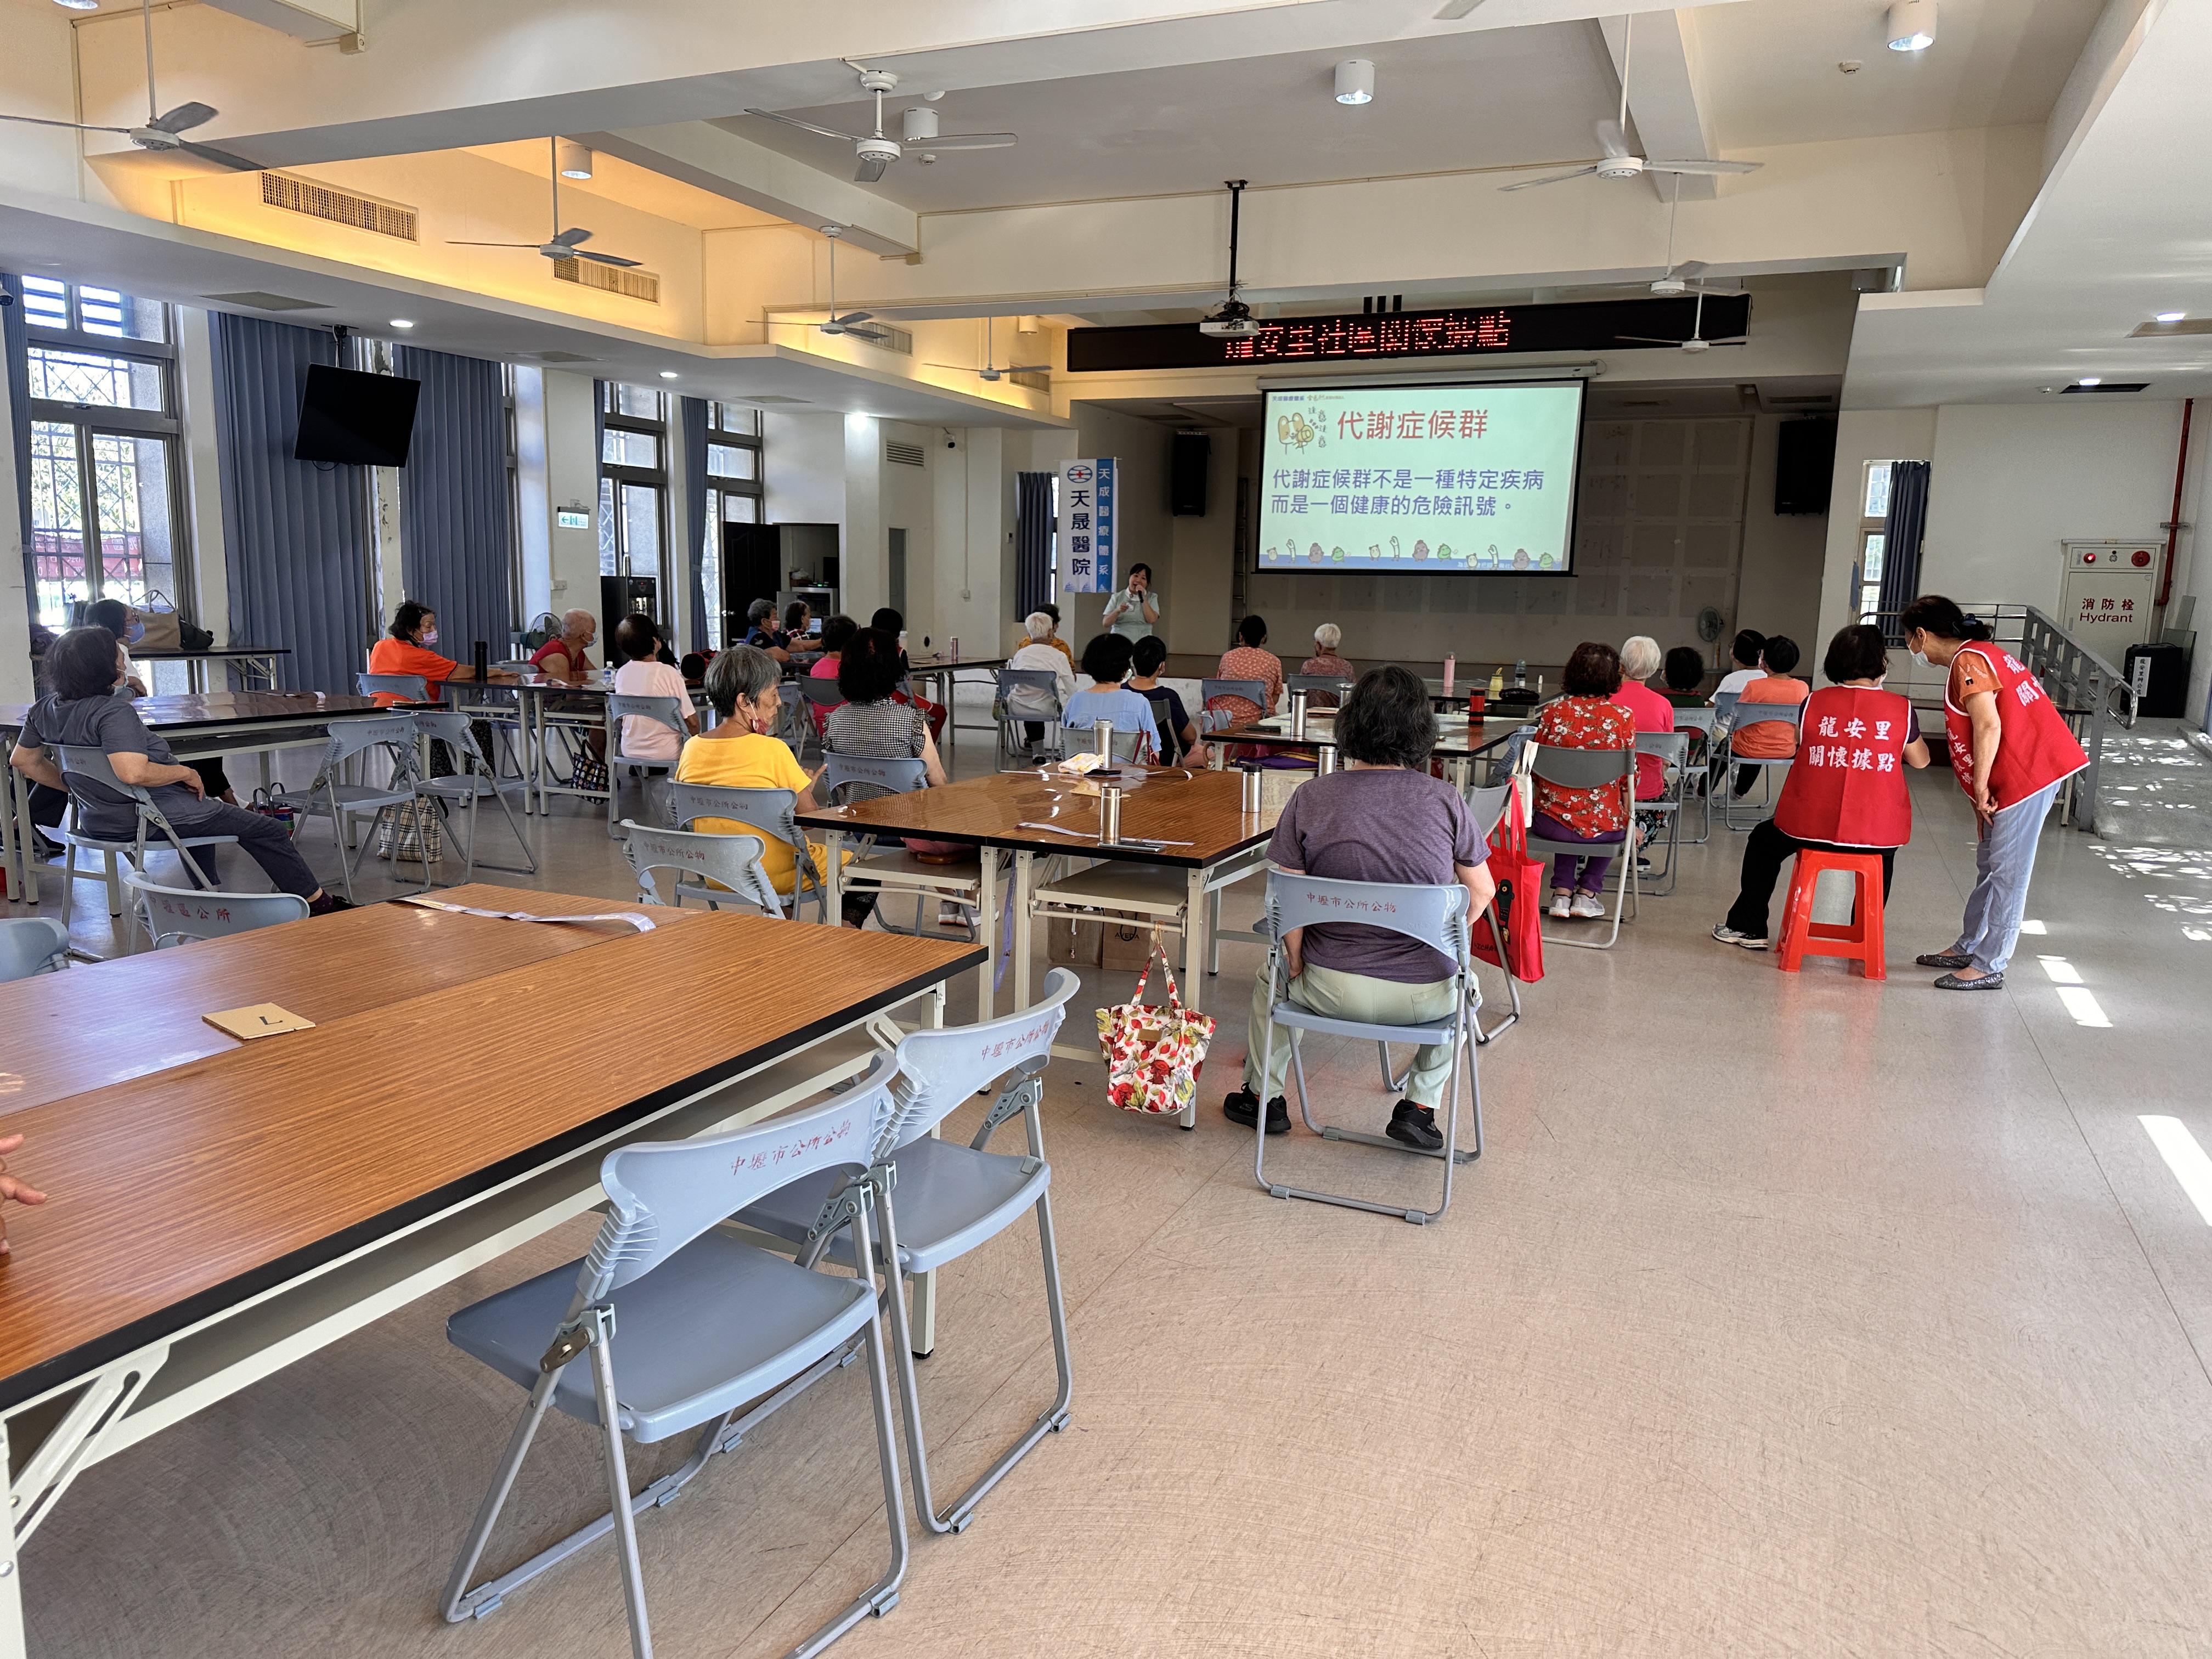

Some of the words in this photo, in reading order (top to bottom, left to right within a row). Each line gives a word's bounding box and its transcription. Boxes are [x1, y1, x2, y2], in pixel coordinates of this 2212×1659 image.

[1337, 409, 1488, 439] 代謝症候群
[1272, 469, 1544, 490] 代謝症候群不是一種特定疾病
[1271, 494, 1511, 516] 而是一個健康的危險訊號。
[1070, 490, 1091, 575] 天晟醫院
[1098, 468, 1110, 575] 天成醫療體系
[2081, 598, 2134, 611] 消防栓
[2079, 612, 2133, 623] Hydrant
[1818, 715, 1892, 741] 龍安里
[1809, 744, 1895, 772] 關懷據點
[1306, 891, 1397, 913] 中壢市公所公物
